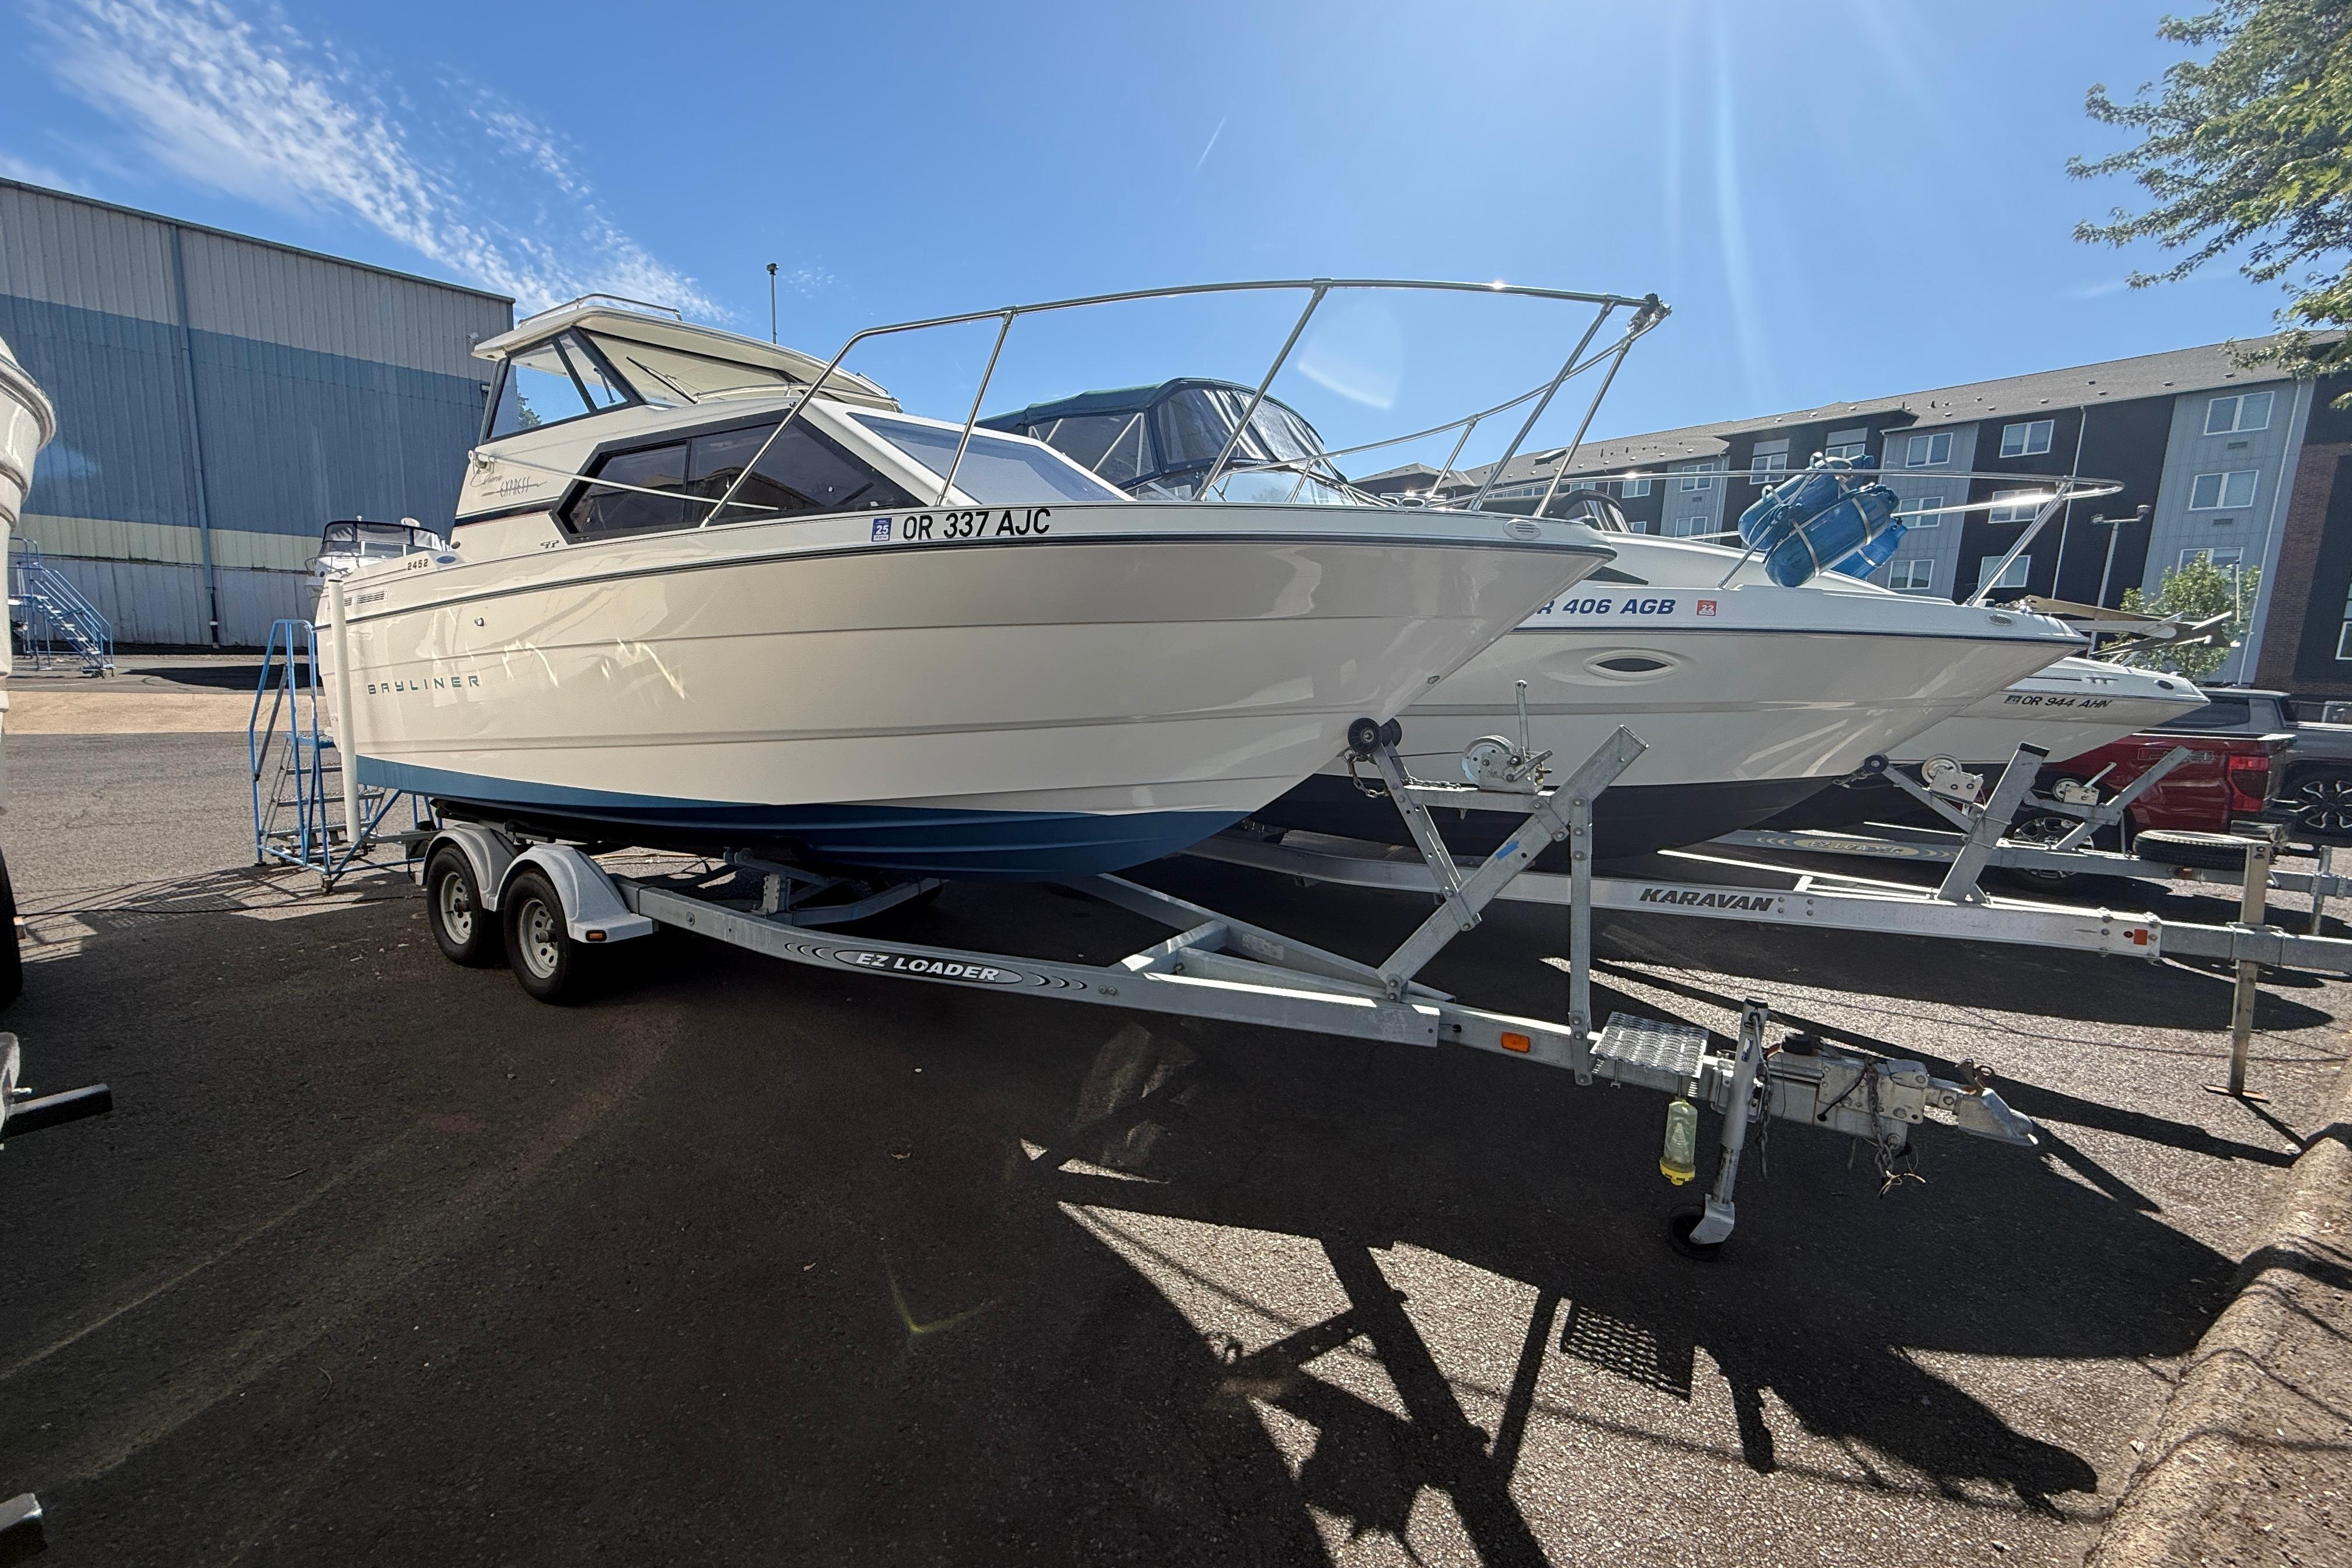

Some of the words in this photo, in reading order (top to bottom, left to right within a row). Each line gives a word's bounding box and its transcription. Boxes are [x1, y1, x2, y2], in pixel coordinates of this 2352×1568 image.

[876, 524, 889, 535] 25
[903, 515, 933, 541] OR
[943, 511, 990, 539] 337
[995, 508, 1051, 536] AJC
[407, 558, 428, 570] 2452
[1562, 598, 1612, 614] 406
[1619, 599, 1676, 614] AGB
[368, 675, 480, 695] BAYLINER
[2021, 696, 2043, 706] OR
[2044, 697, 2076, 707] 944
[2077, 699, 2113, 708] AHN
[1808, 840, 1831, 849] EZ
[1639, 888, 1774, 911] KARAVAN
[856, 953, 890, 968] EZ
[892, 957, 1000, 981] LOADER
